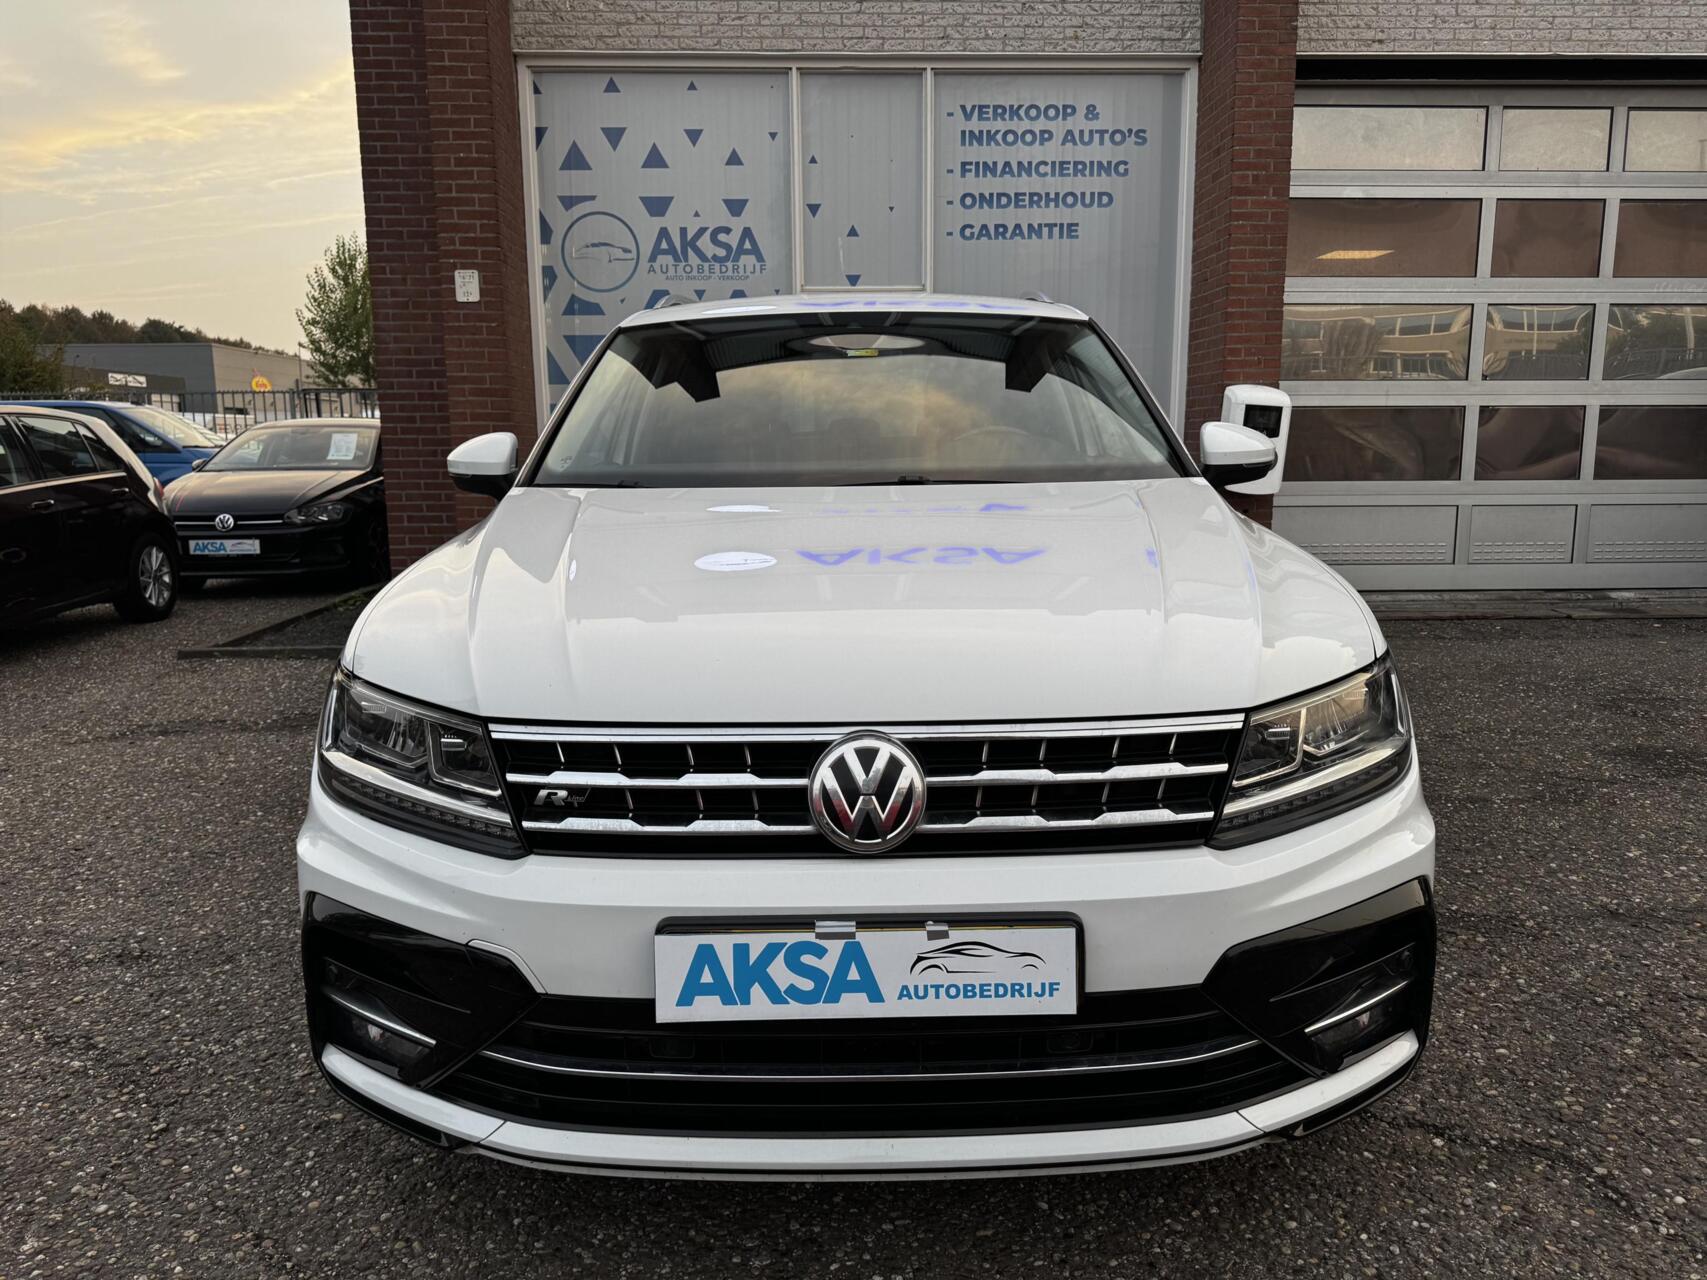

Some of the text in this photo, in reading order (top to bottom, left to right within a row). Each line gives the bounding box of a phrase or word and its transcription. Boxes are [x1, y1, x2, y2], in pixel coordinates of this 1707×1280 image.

[959, 104, 1077, 122] VERKOOP
[1083, 103, 1100, 122] &
[960, 128, 1148, 147] INKOOP AUTO'S
[960, 160, 1129, 178] FINANCIERING
[959, 191, 1114, 209] ONDERHOUD
[959, 223, 1080, 241] GARANTIE
[647, 225, 767, 264] AKSA
[647, 263, 767, 275] AUTOBEDRIJF
[193, 541, 228, 554] AKSA
[675, 940, 1061, 1007] AKSA AUTOBEDRIJF
